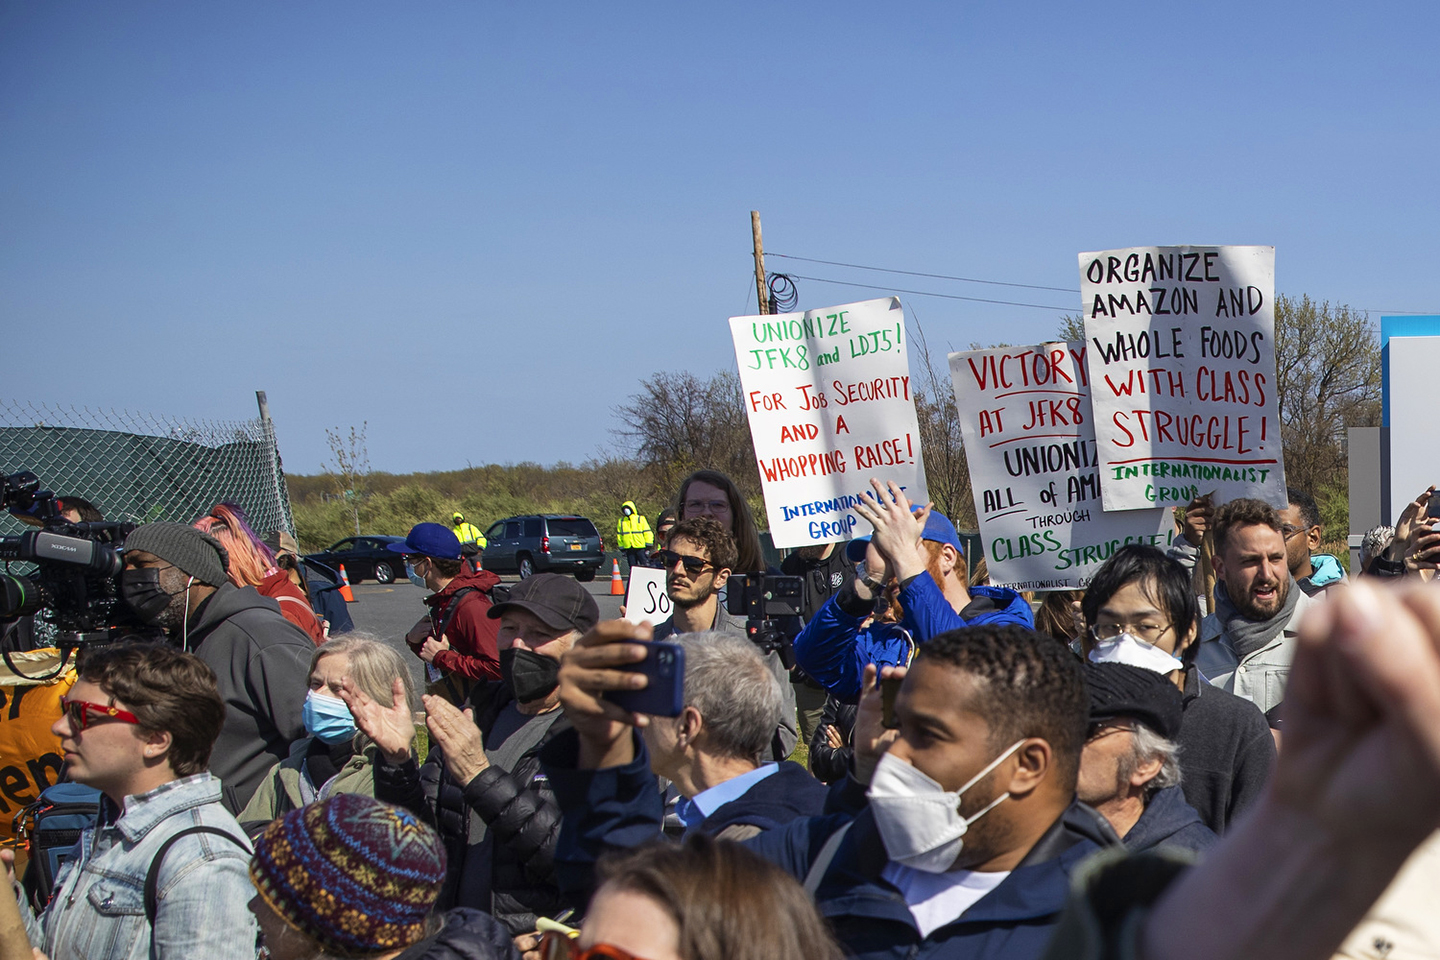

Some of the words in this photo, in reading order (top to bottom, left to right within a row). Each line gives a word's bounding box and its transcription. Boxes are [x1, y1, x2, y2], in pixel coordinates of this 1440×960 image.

[1086, 252, 1220, 284] ORGANIZE
[1091, 286, 1199, 319] AMAZON
[1215, 285, 1263, 319] AND
[752, 311, 851, 343] UNIONIZE
[747, 345, 810, 371] JFK8
[816, 346, 840, 367] and
[850, 322, 901, 359] LDJ5!
[1092, 327, 1185, 365] WHOLE
[1200, 326, 1264, 365] FOODS
[967, 347, 1088, 391] VICTORY
[749, 390, 787, 413] FOR
[833, 376, 910, 406] SECURITY
[1104, 368, 1185, 398] WITH
[1196, 365, 1267, 408] CLASS
[780, 423, 819, 444] AND
[836, 414, 850, 435] A
[979, 407, 1006, 438] AT
[1022, 397, 1084, 431] JFK8
[1111, 410, 1267, 455] STRUGGLE!
[759, 450, 847, 483] WHOPPING
[854, 433, 914, 470] RAISE!
[1110, 461, 1270, 484] INTERNATIONALIST
[983, 487, 1024, 514] ALL
[1039, 481, 1058, 507] of
[809, 514, 857, 539] GROUP
[1025, 509, 1091, 529] THROUGH
[992, 529, 1062, 563] CLASS
